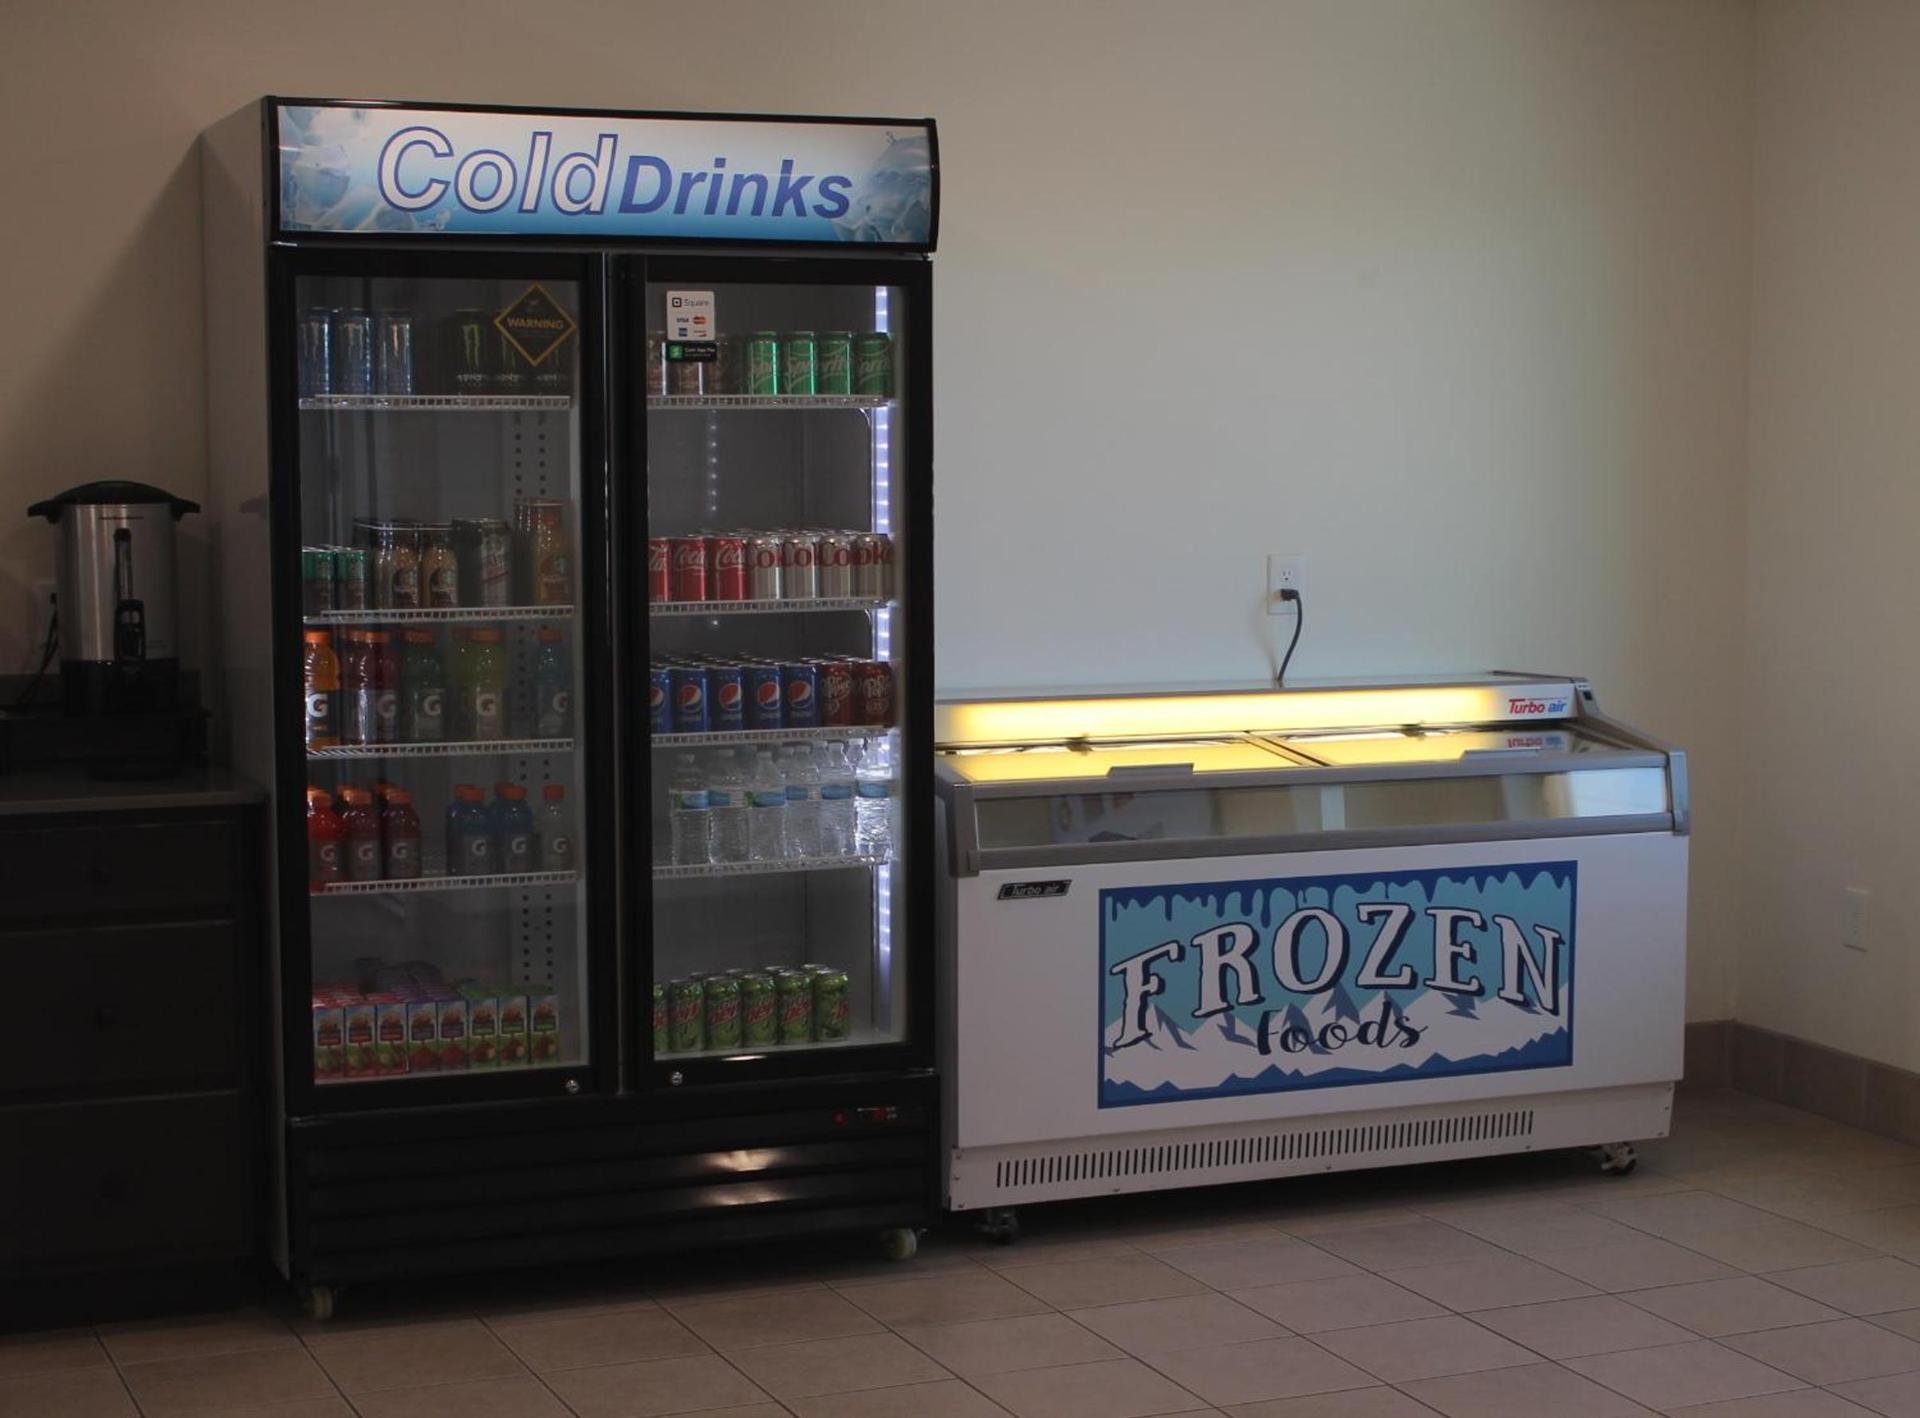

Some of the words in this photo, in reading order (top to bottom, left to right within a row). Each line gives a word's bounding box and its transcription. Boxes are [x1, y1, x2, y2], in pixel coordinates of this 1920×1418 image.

[378, 126, 618, 216] Cold
[618, 156, 853, 219] Drinks
[506, 317, 564, 330] WARNING
[307, 693, 328, 718] G
[377, 694, 397, 716] G
[423, 694, 441, 716] G
[476, 693, 496, 716] G
[553, 691, 568, 713] G
[1508, 698, 1545, 714] Turbo
[1548, 699, 1567, 713] air
[1110, 902, 1566, 1049] FROZEN
[1257, 999, 1428, 1055] foods
